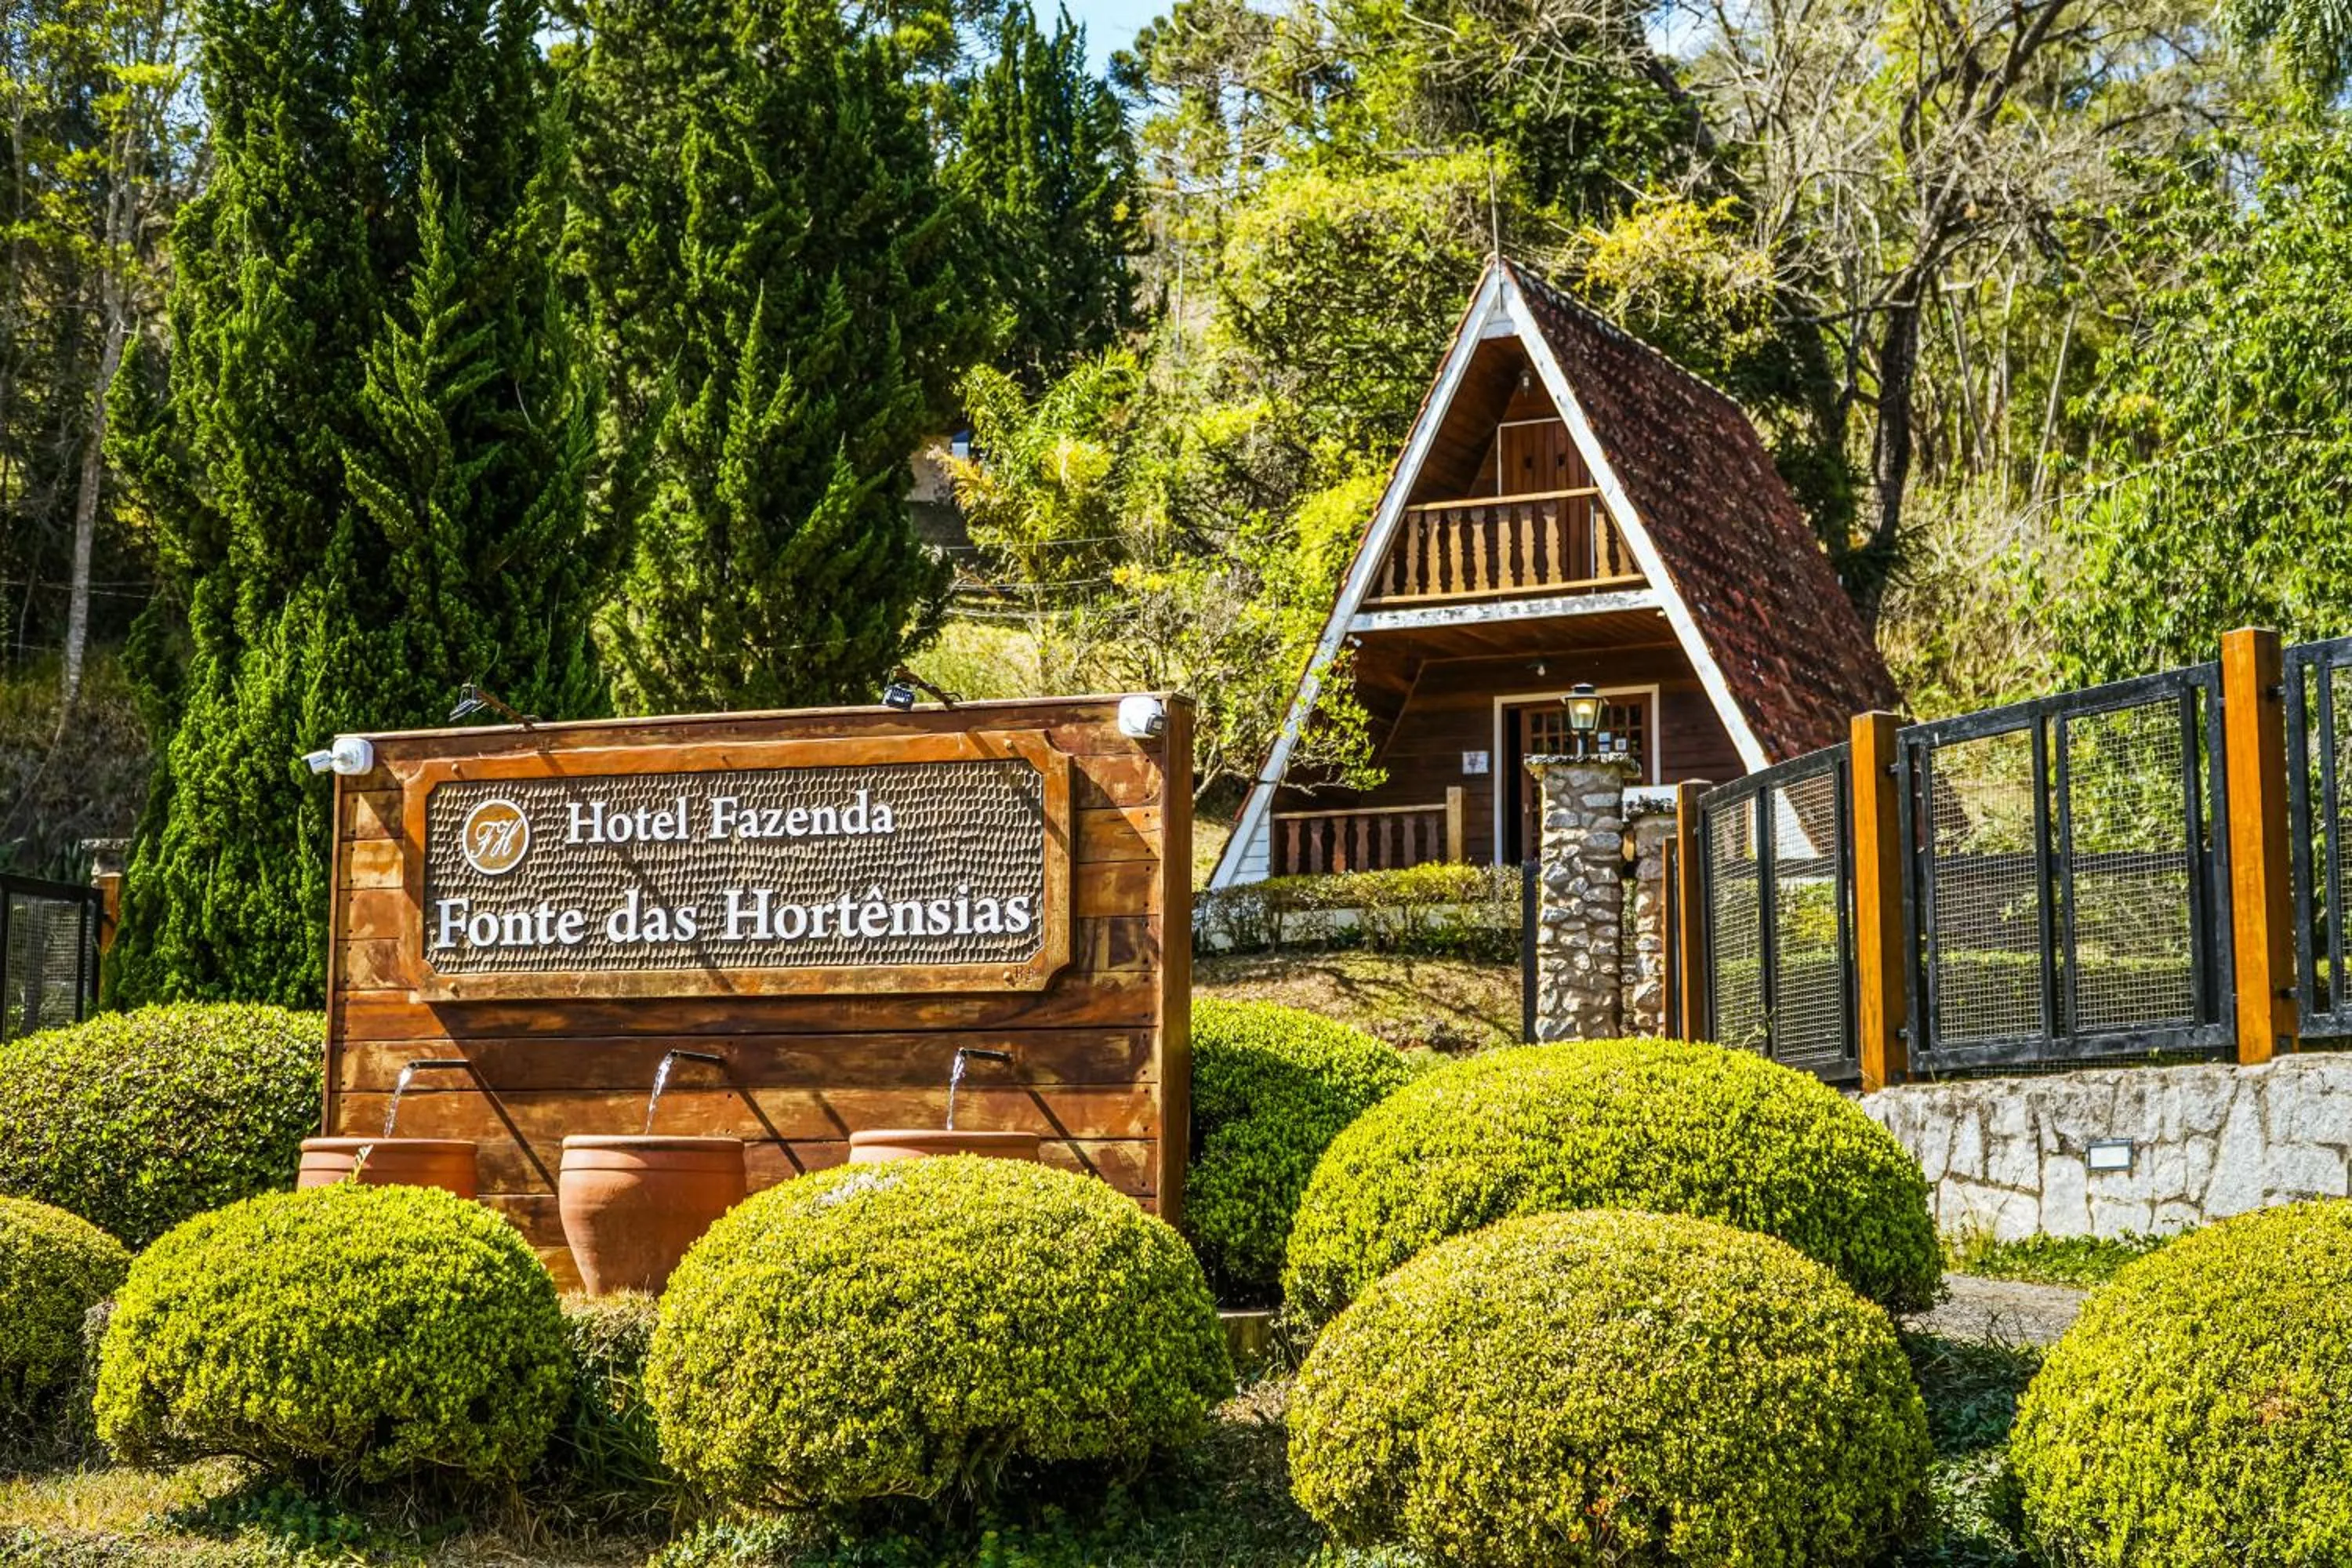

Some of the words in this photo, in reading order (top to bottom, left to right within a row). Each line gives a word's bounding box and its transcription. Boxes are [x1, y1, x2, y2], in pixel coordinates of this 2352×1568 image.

[565, 796, 690, 844] Hotel
[708, 788, 895, 840] Fazenda
[434, 898, 586, 949] Fonte
[606, 887, 698, 944] das
[720, 884, 1032, 941] Hortênsias
